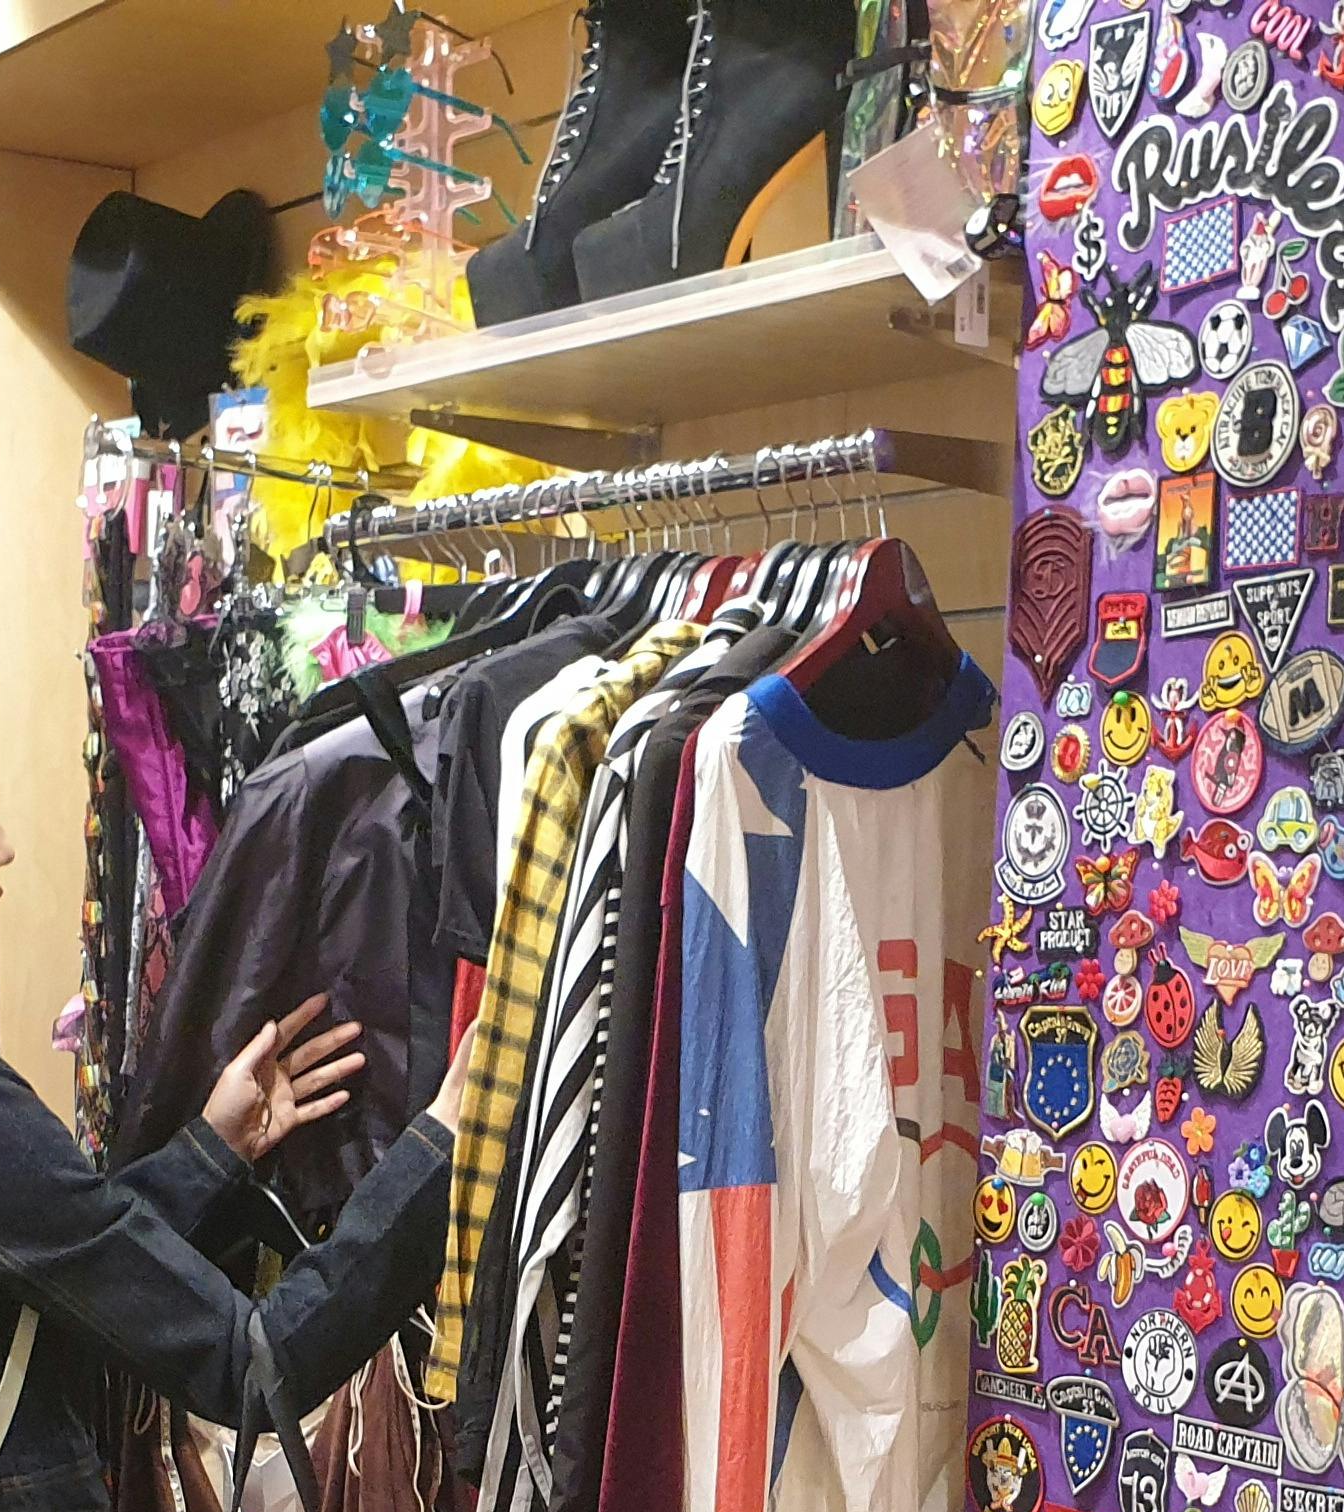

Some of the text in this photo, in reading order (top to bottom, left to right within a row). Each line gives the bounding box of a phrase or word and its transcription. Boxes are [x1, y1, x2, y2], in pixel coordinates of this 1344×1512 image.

[1251, 0, 1311, 60] COOL
[1288, 681, 1325, 724] M
[1039, 928, 1092, 951] PRODUCT
[1049, 910, 1085, 931] STAR
[1121, 1150, 1159, 1190] GRATEFUL
[1049, 1284, 1121, 1365] CA
[1130, 1312, 1195, 1359] NORTHERN
[1131, 1385, 1177, 1412] SOUL
[1177, 1422, 1279, 1467] ROAD CAPTAIN
